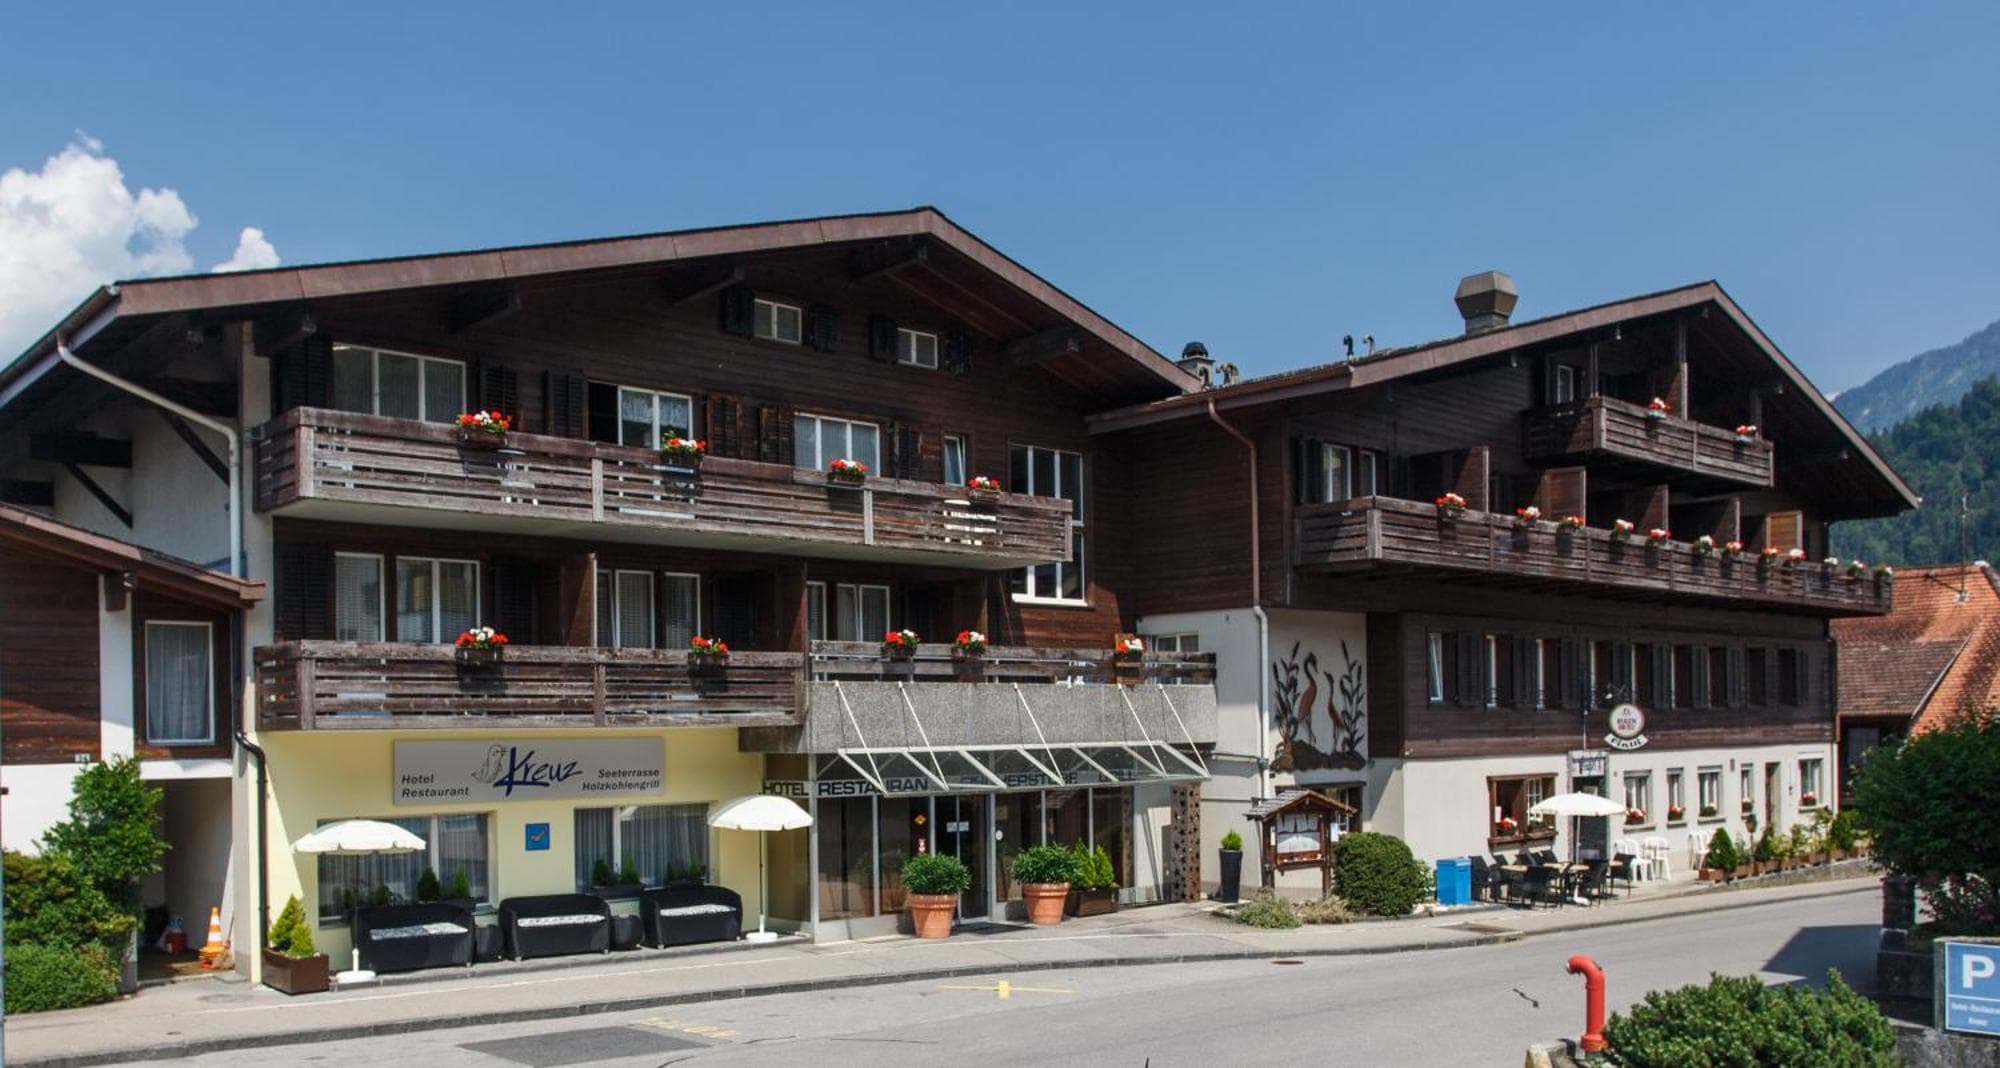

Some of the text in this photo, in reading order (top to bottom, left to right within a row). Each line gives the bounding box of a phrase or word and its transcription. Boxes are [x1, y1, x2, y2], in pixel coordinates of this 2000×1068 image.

[493, 747, 583, 798] Kreuz
[598, 768, 660, 779] Seeterrasse
[401, 773, 435, 786] Hotel
[582, 779, 660, 792] Holzkohlengrill
[402, 786, 470, 798] Restaurant
[762, 781, 809, 797] HOTEL
[818, 777, 936, 797] RESTARAN
[1962, 953, 1996, 989] P
